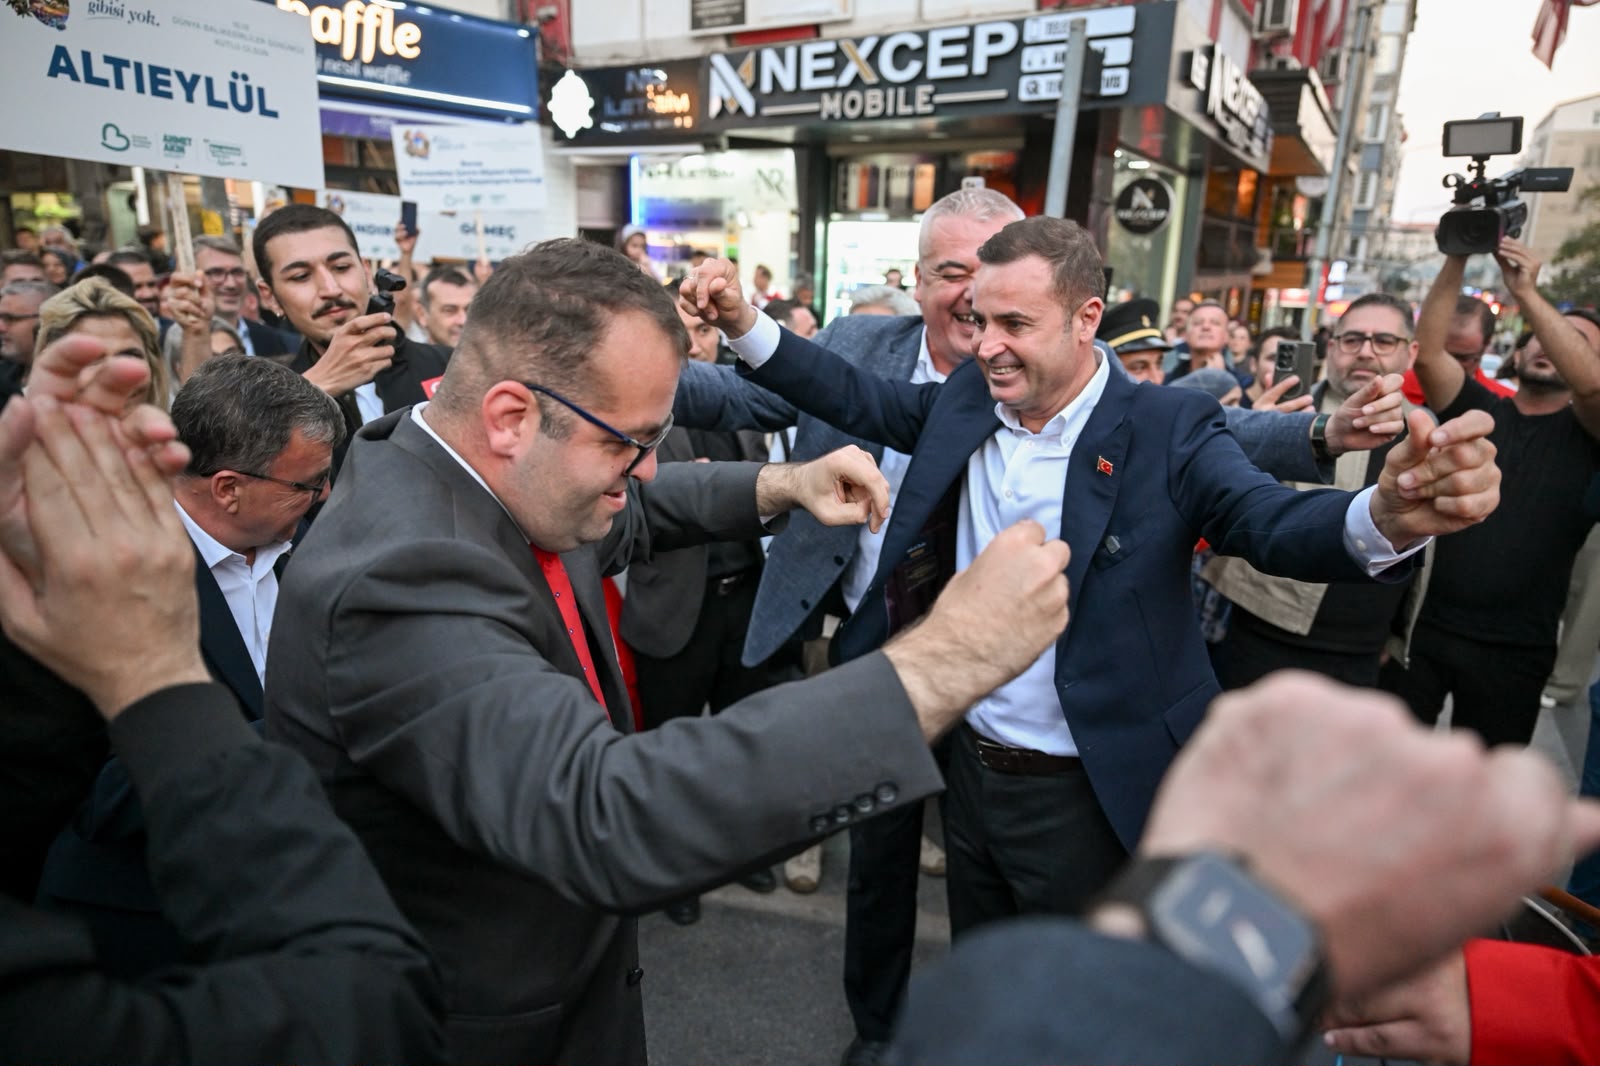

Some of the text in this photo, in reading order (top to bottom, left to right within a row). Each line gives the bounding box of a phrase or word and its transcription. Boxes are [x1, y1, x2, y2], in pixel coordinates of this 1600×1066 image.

[87, 0, 160, 27] gibisi yok.
[47, 44, 279, 119] ALTIEYLÜL
[759, 20, 1019, 95] NEXCEP
[819, 84, 935, 120] MOBILE
